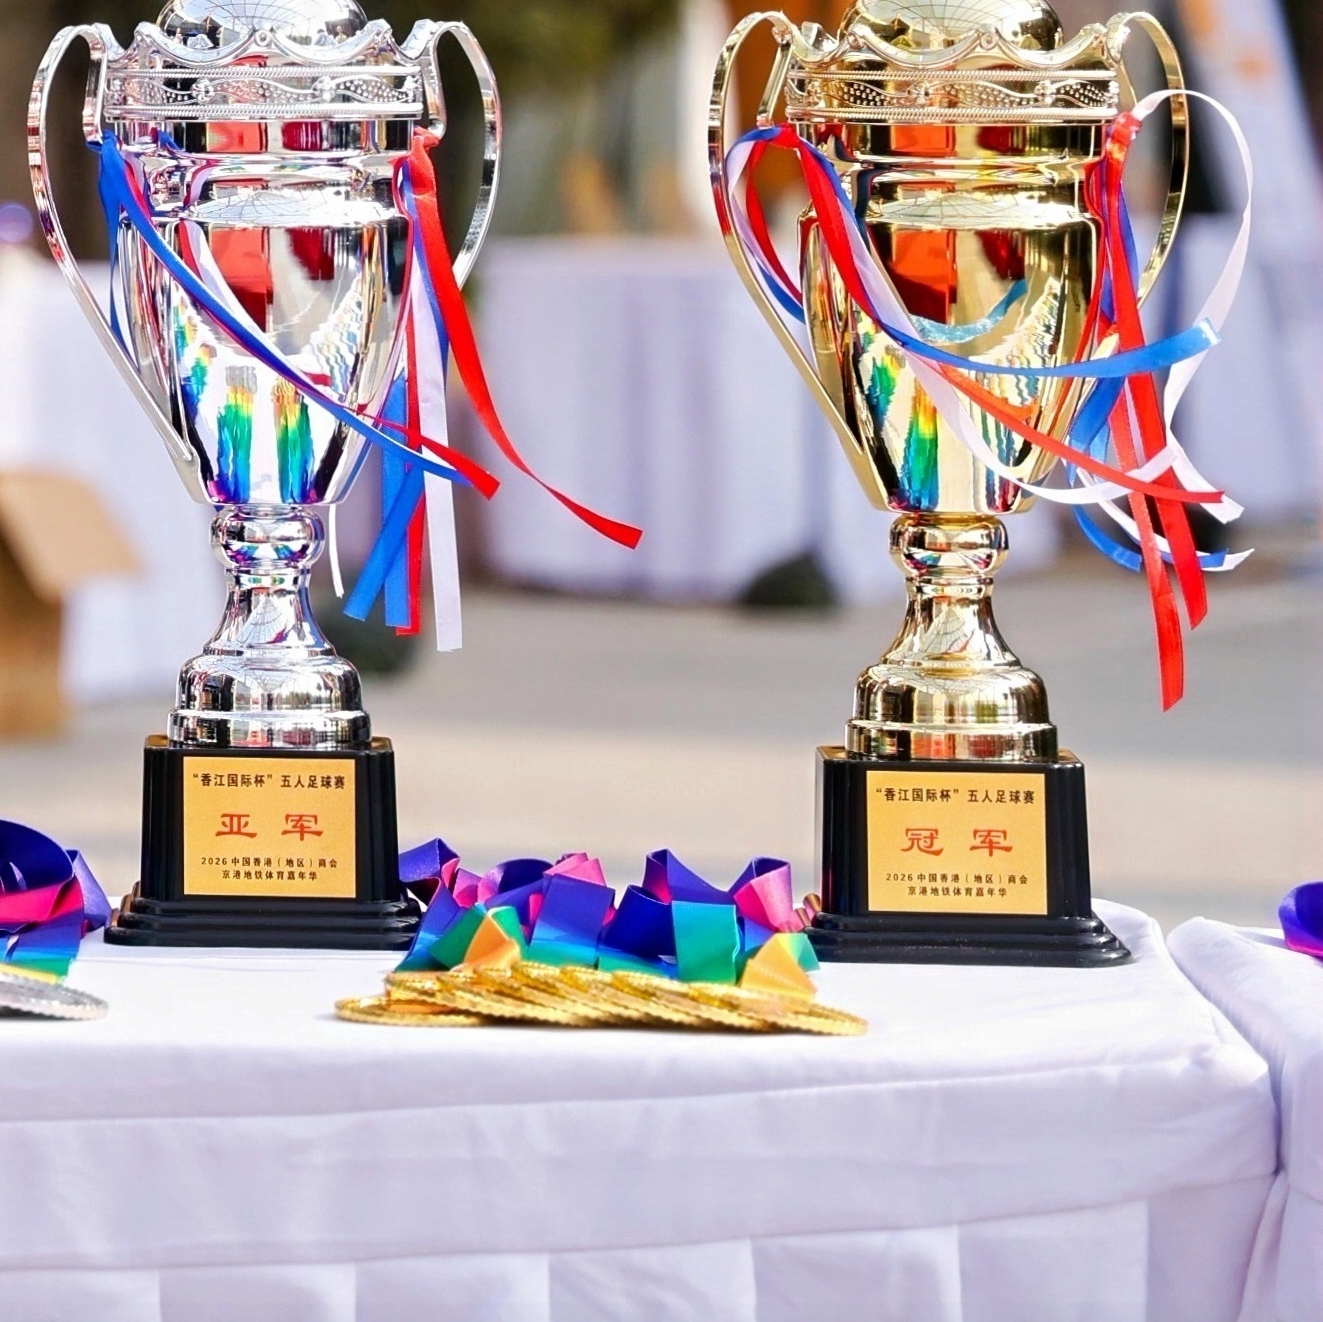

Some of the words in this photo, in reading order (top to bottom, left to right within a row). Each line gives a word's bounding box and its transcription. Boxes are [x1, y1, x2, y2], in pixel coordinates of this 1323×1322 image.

[214, 812, 324, 842] 亚军
[899, 827, 1014, 858] 冠军
[222, 869, 318, 882] 京港地铁体育嘉年华
[908, 885, 1007, 898] 京港地铁体育嘉年华
